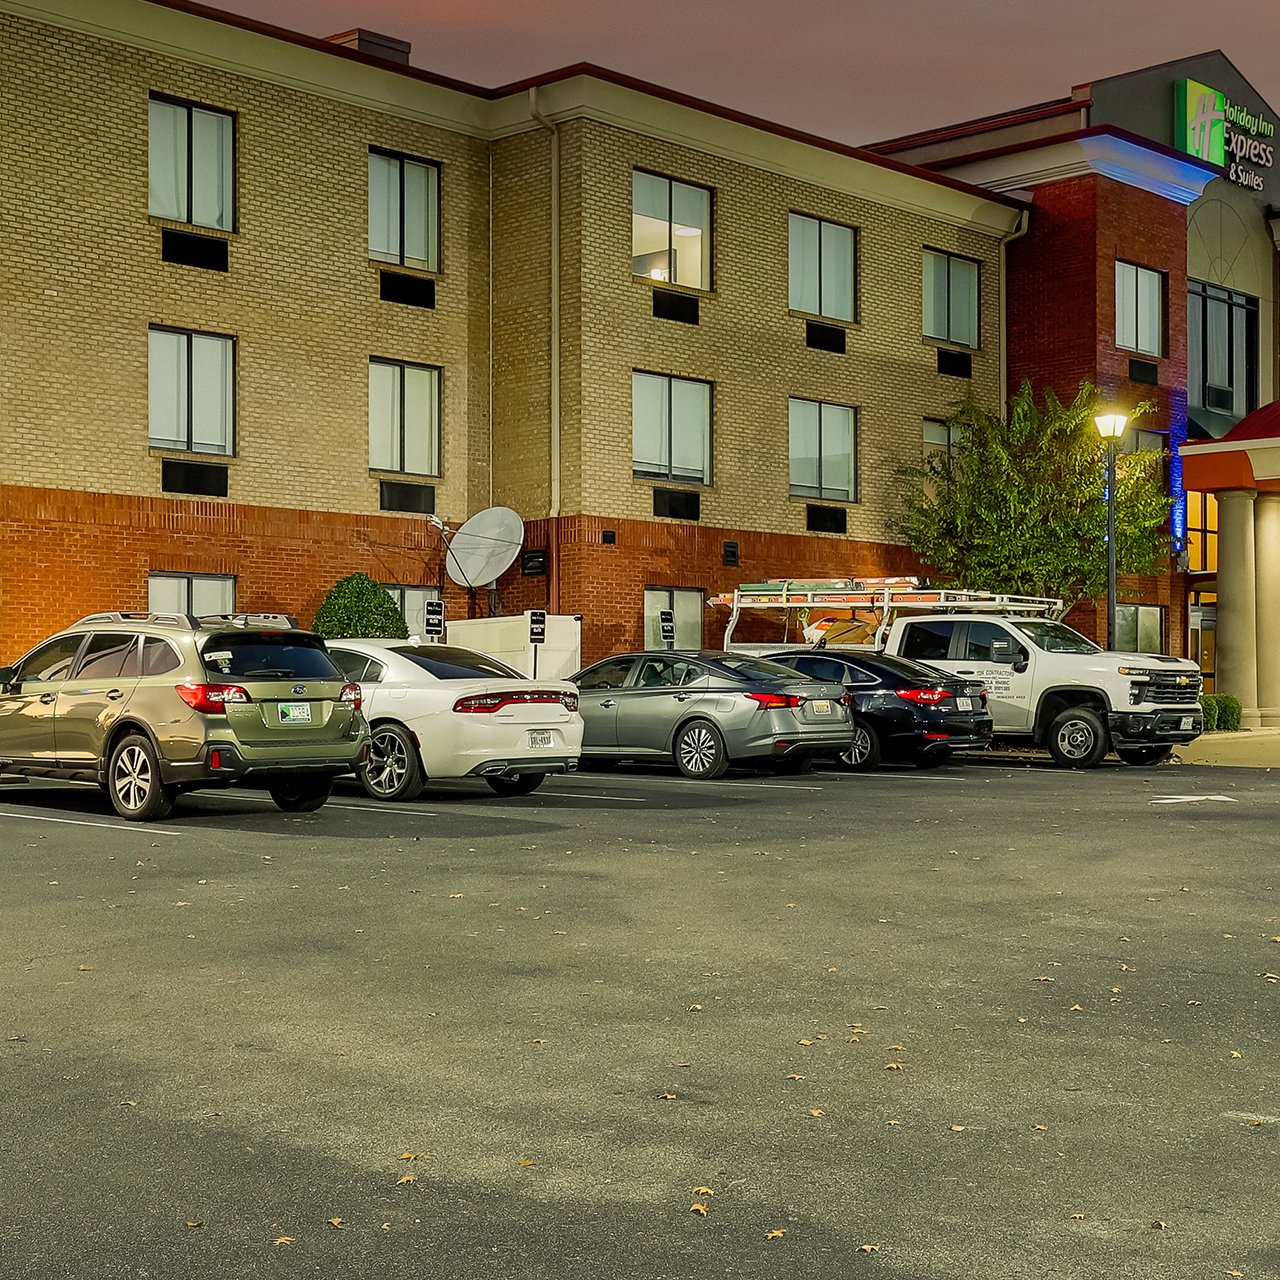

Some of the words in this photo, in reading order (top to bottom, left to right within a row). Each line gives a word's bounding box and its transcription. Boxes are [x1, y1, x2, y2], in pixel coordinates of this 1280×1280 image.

[1223, 97, 1258, 135] Holiday
[1257, 113, 1275, 138] Inn
[1223, 122, 1275, 168] Express
[1228, 163, 1237, 181] &
[1237, 166, 1264, 191] Suites
